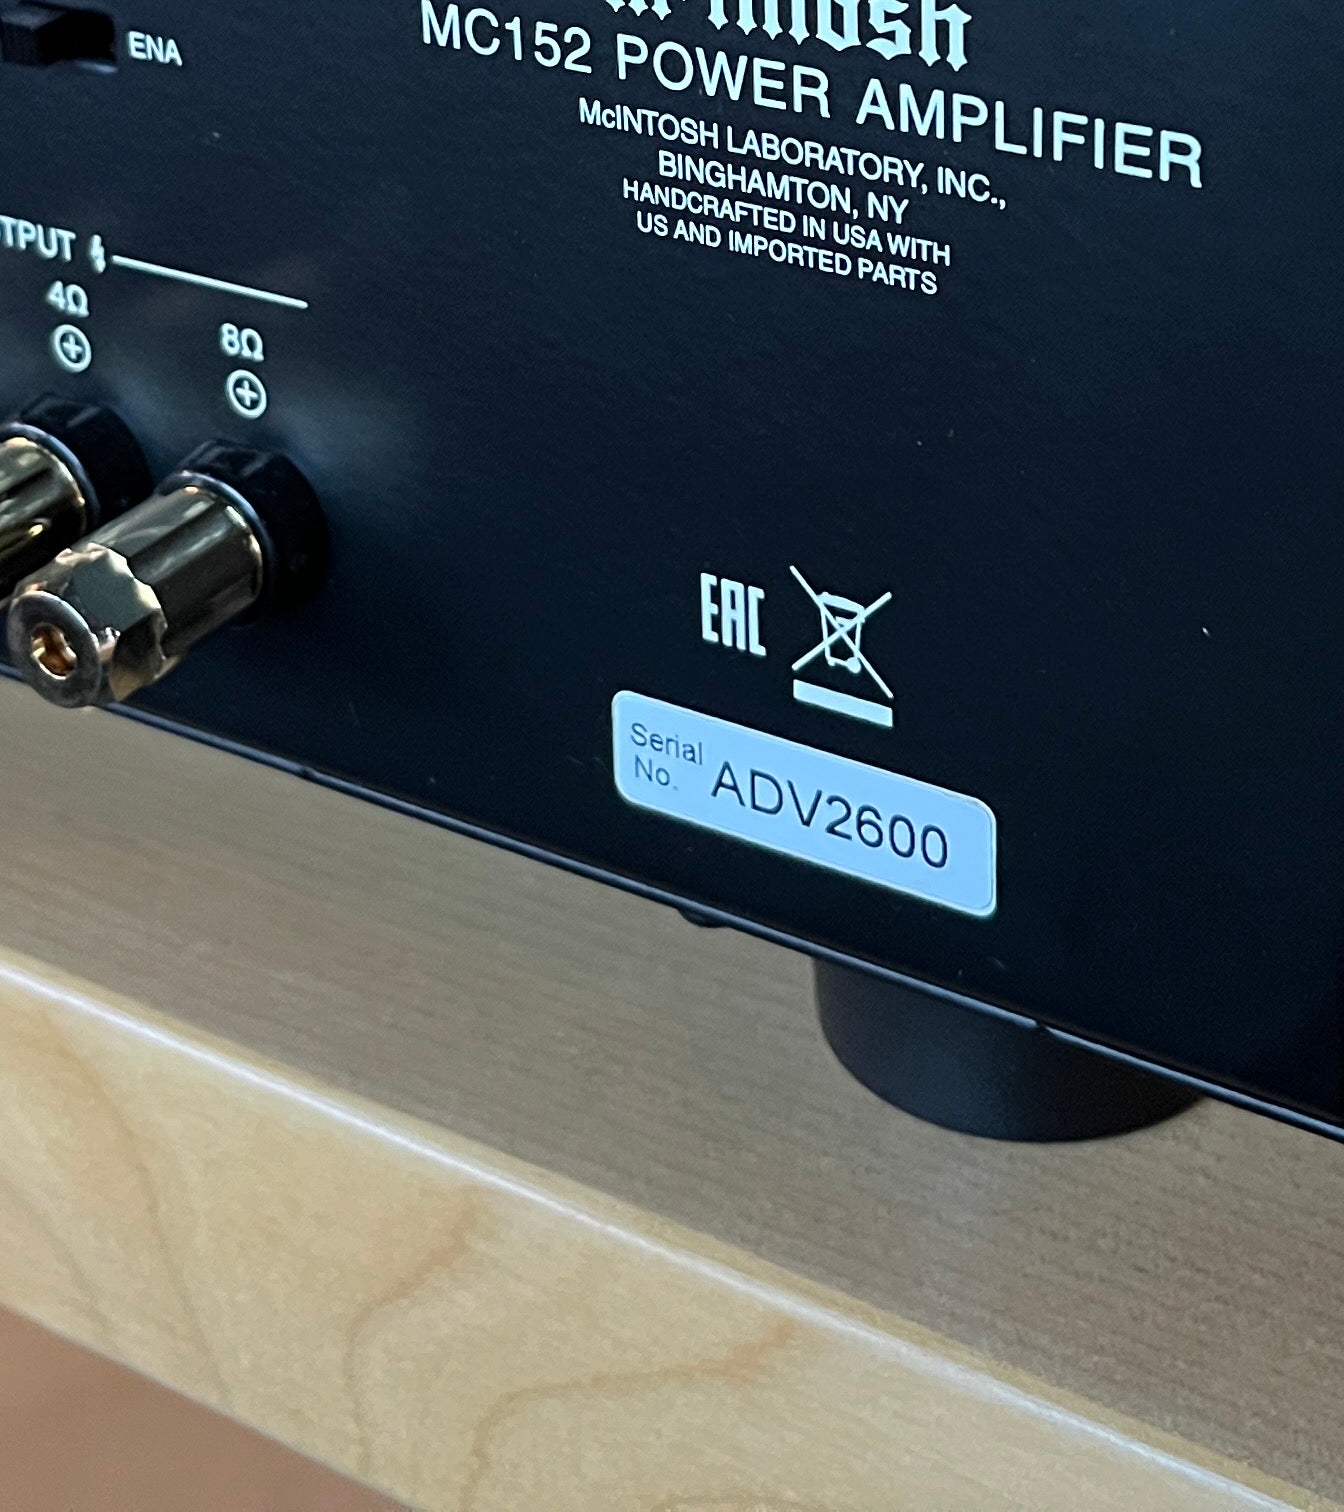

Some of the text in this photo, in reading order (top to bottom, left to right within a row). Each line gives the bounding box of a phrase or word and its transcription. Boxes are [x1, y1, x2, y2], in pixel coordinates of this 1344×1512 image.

[127, 31, 183, 66] ENA
[616, 32, 831, 119] POWER
[855, 77, 1203, 189] AMPLIFIER
[578, 97, 1006, 210] McINTOSH LABORATORY, INC.,
[658, 149, 910, 225] BINGHAMTON, NY
[623, 177, 951, 267] HANDCRAFTED IN USA WITH
[636, 210, 938, 295] US AND IMPORTED PARTS
[630, 722, 703, 766] Serial
[634, 755, 679, 792] No.
[710, 761, 949, 870] ADV2600
